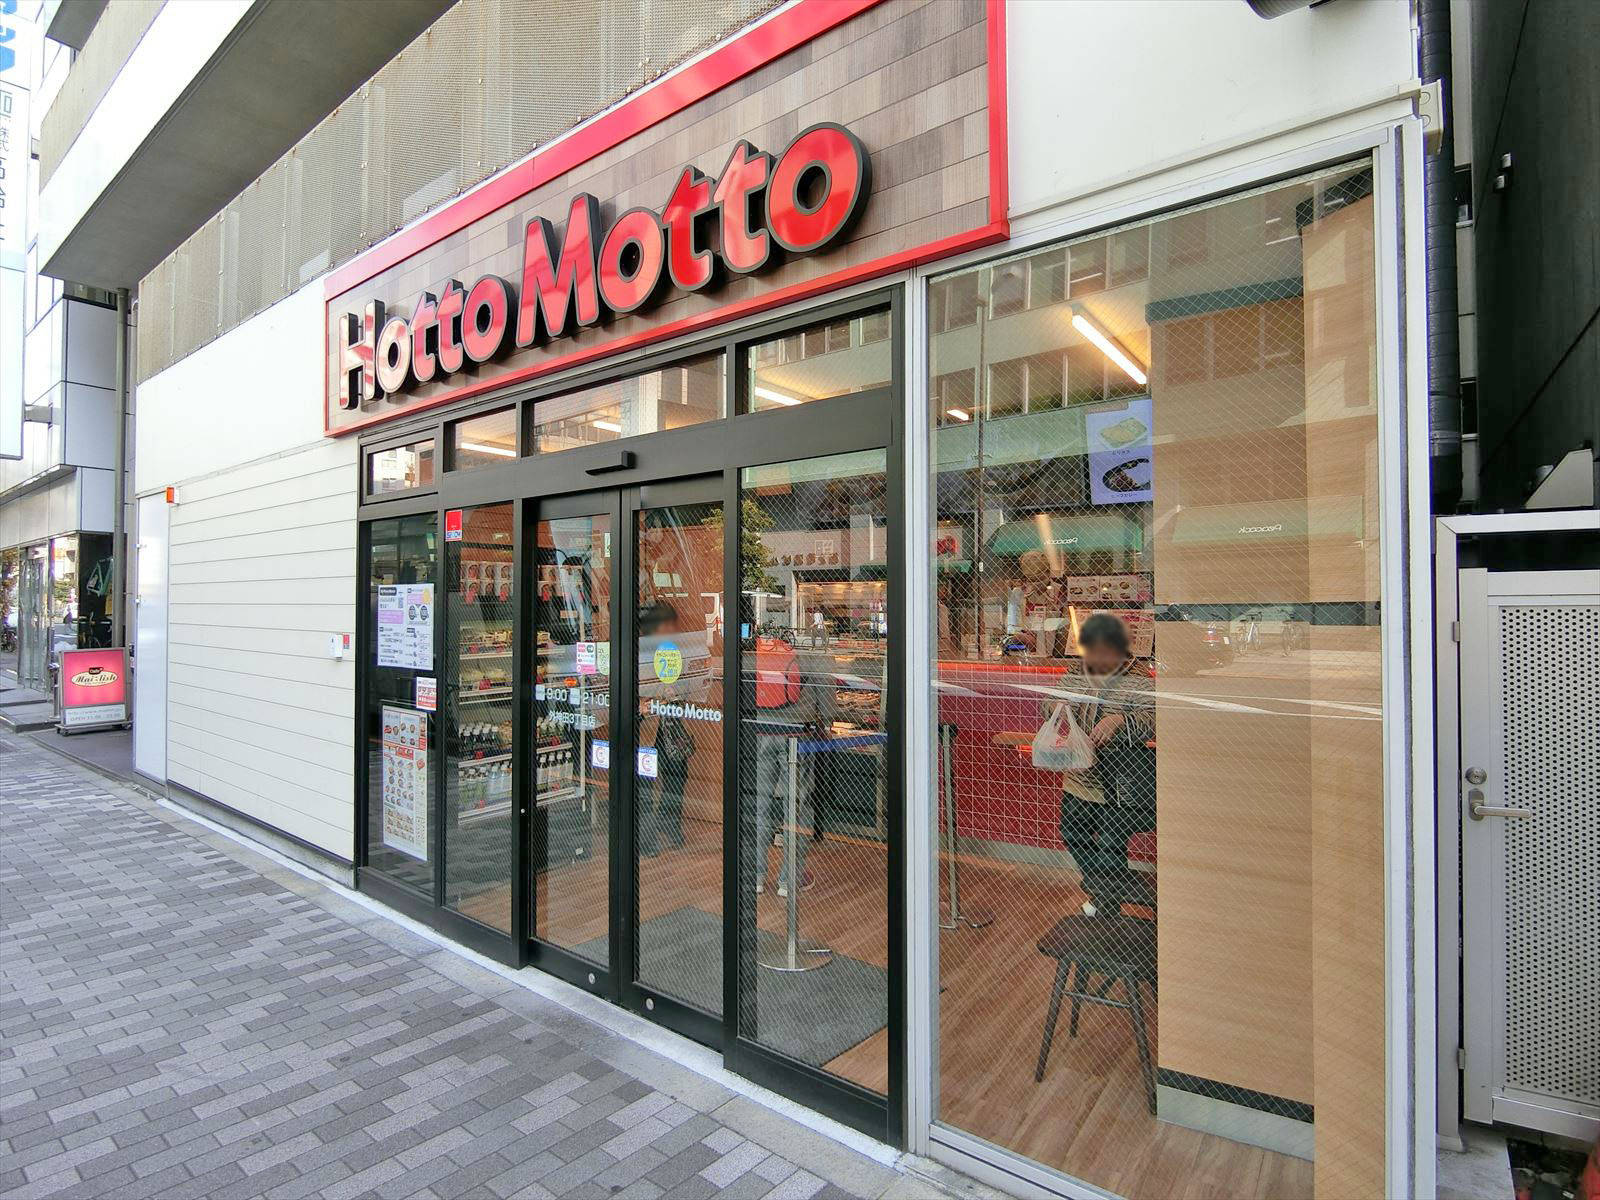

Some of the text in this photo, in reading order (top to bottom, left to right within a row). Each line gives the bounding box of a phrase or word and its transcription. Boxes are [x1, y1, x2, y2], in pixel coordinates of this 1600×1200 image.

[338, 121, 873, 411] Hotto Motto
[546, 687, 568, 701] 9:00
[650, 699, 722, 722] Hotto Motto
